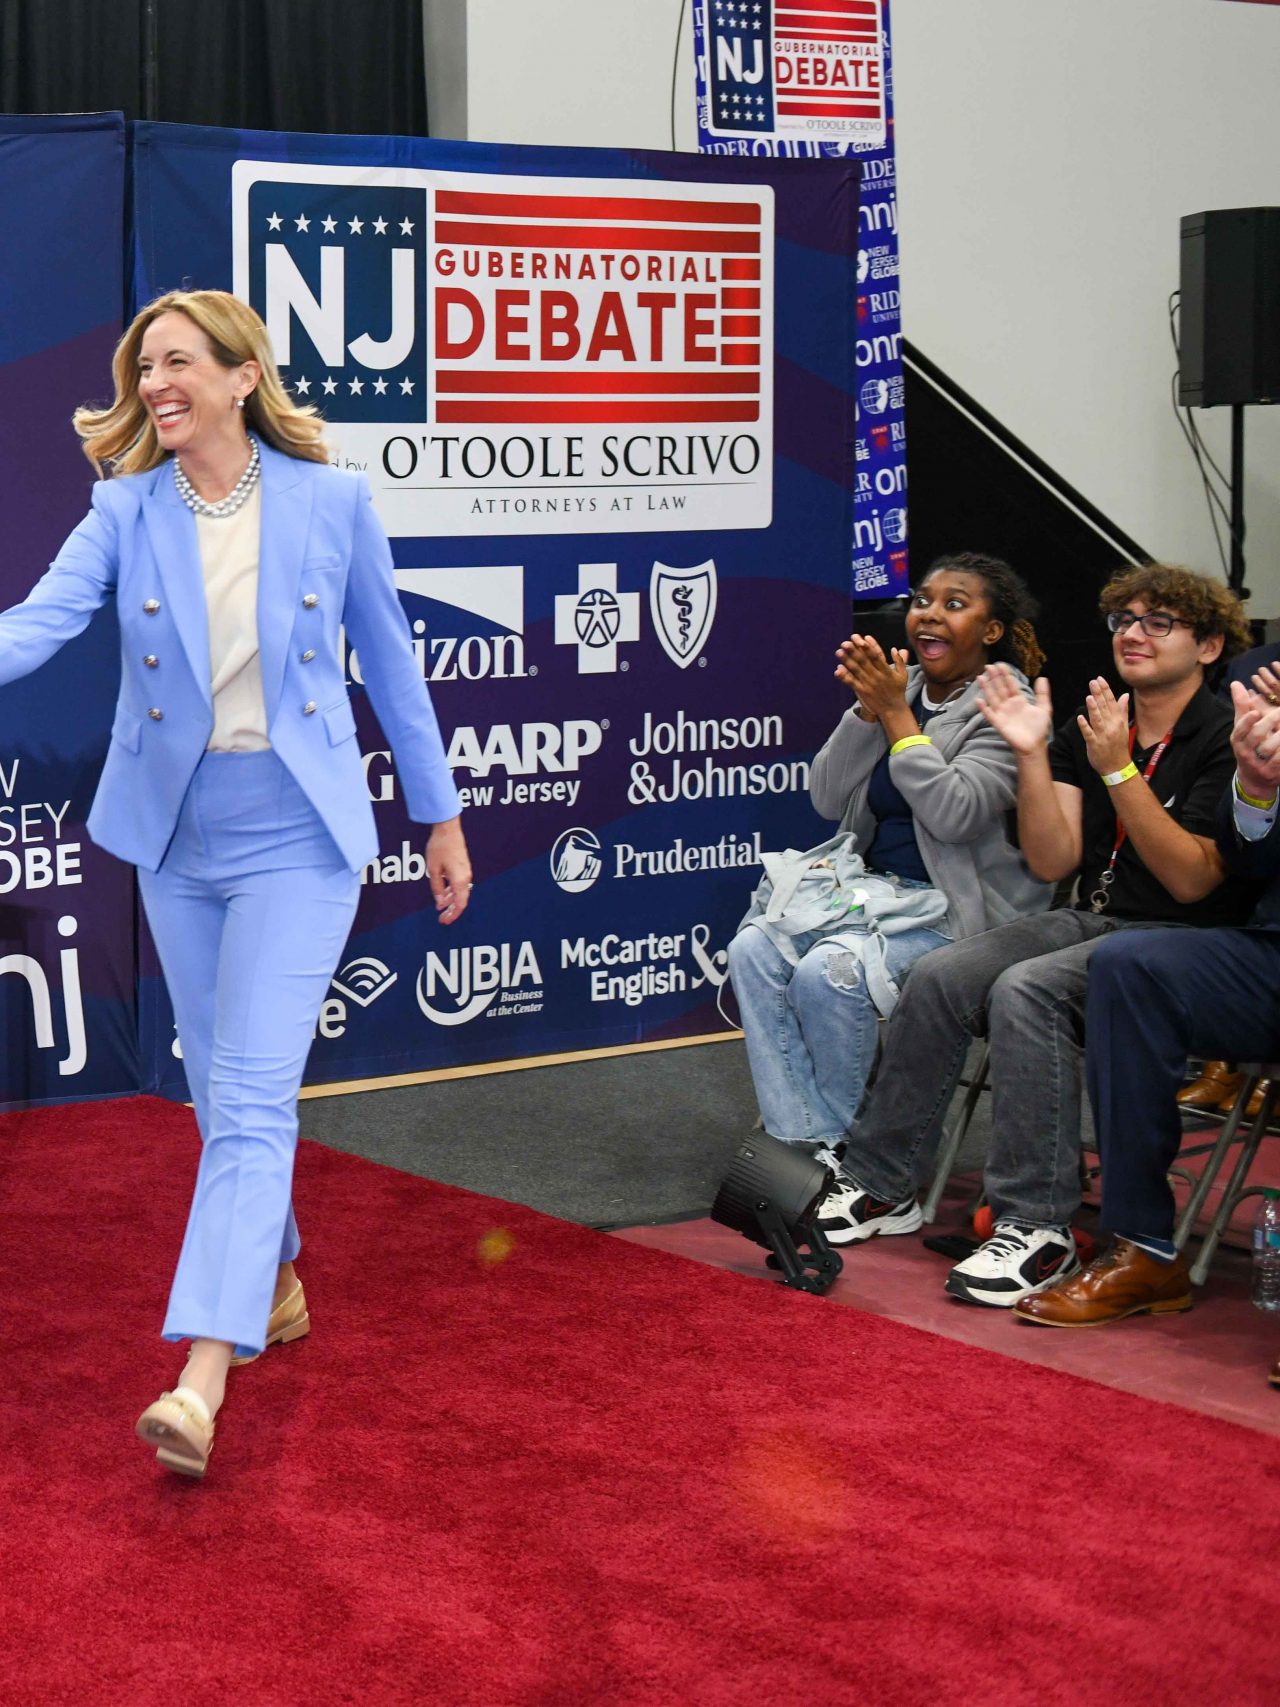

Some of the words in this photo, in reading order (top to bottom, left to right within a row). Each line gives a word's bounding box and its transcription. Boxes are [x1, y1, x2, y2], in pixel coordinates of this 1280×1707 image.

[717, 35, 764, 84] NJ
[775, 41, 879, 57] GUBERNATORIAL
[775, 56, 880, 88] DEBATE
[434, 248, 718, 282] GUBERNATORIAL
[265, 242, 415, 370] NJ
[434, 287, 718, 362] DEBATE
[381, 435, 583, 479] O'TOOLE
[601, 434, 760, 477] SCRIVO
[854, 574, 889, 592] GLOBE
[628, 711, 783, 757] Johnson
[457, 786, 493, 808] ew
[499, 779, 582, 807] Jersey
[613, 832, 762, 879] Prudential
[561, 931, 685, 969] McCarter
[426, 941, 544, 1007] NJBIA
[591, 961, 687, 1006] English
[486, 1006, 497, 1017] at
[498, 1005, 513, 1016] the
[513, 1003, 544, 1014] Center
[500, 990, 543, 1002] Business
